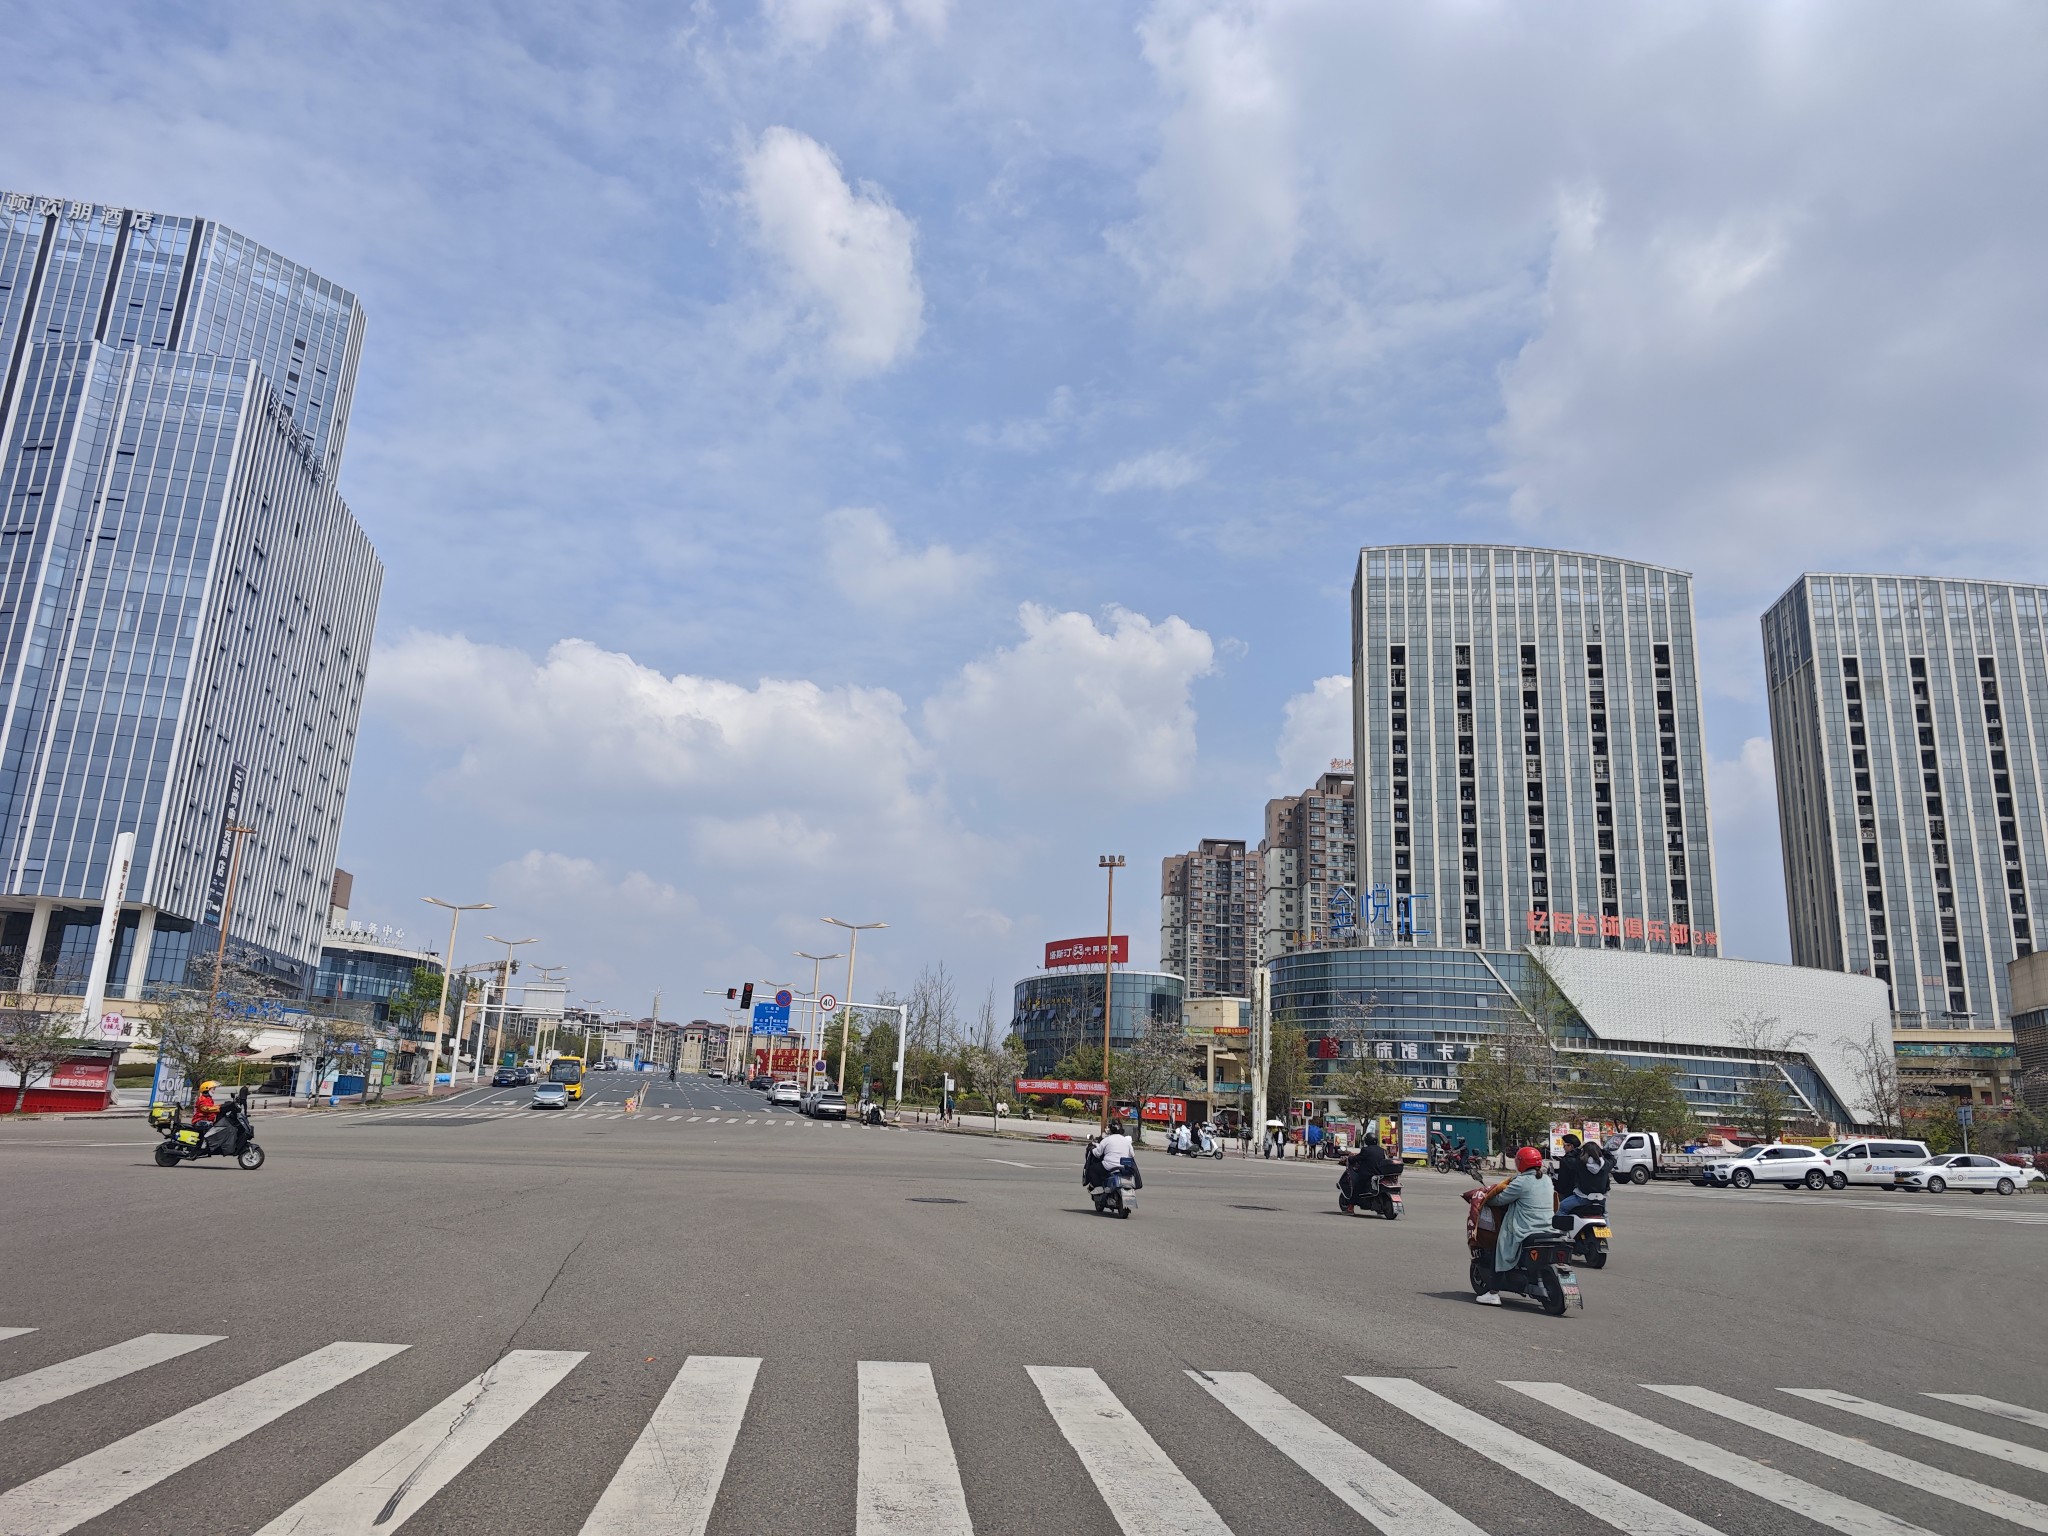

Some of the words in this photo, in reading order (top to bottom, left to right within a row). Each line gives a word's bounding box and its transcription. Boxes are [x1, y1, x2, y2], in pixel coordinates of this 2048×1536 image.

[1330, 883, 1432, 935] 金悦汇
[823, 999, 833, 1007] 40
